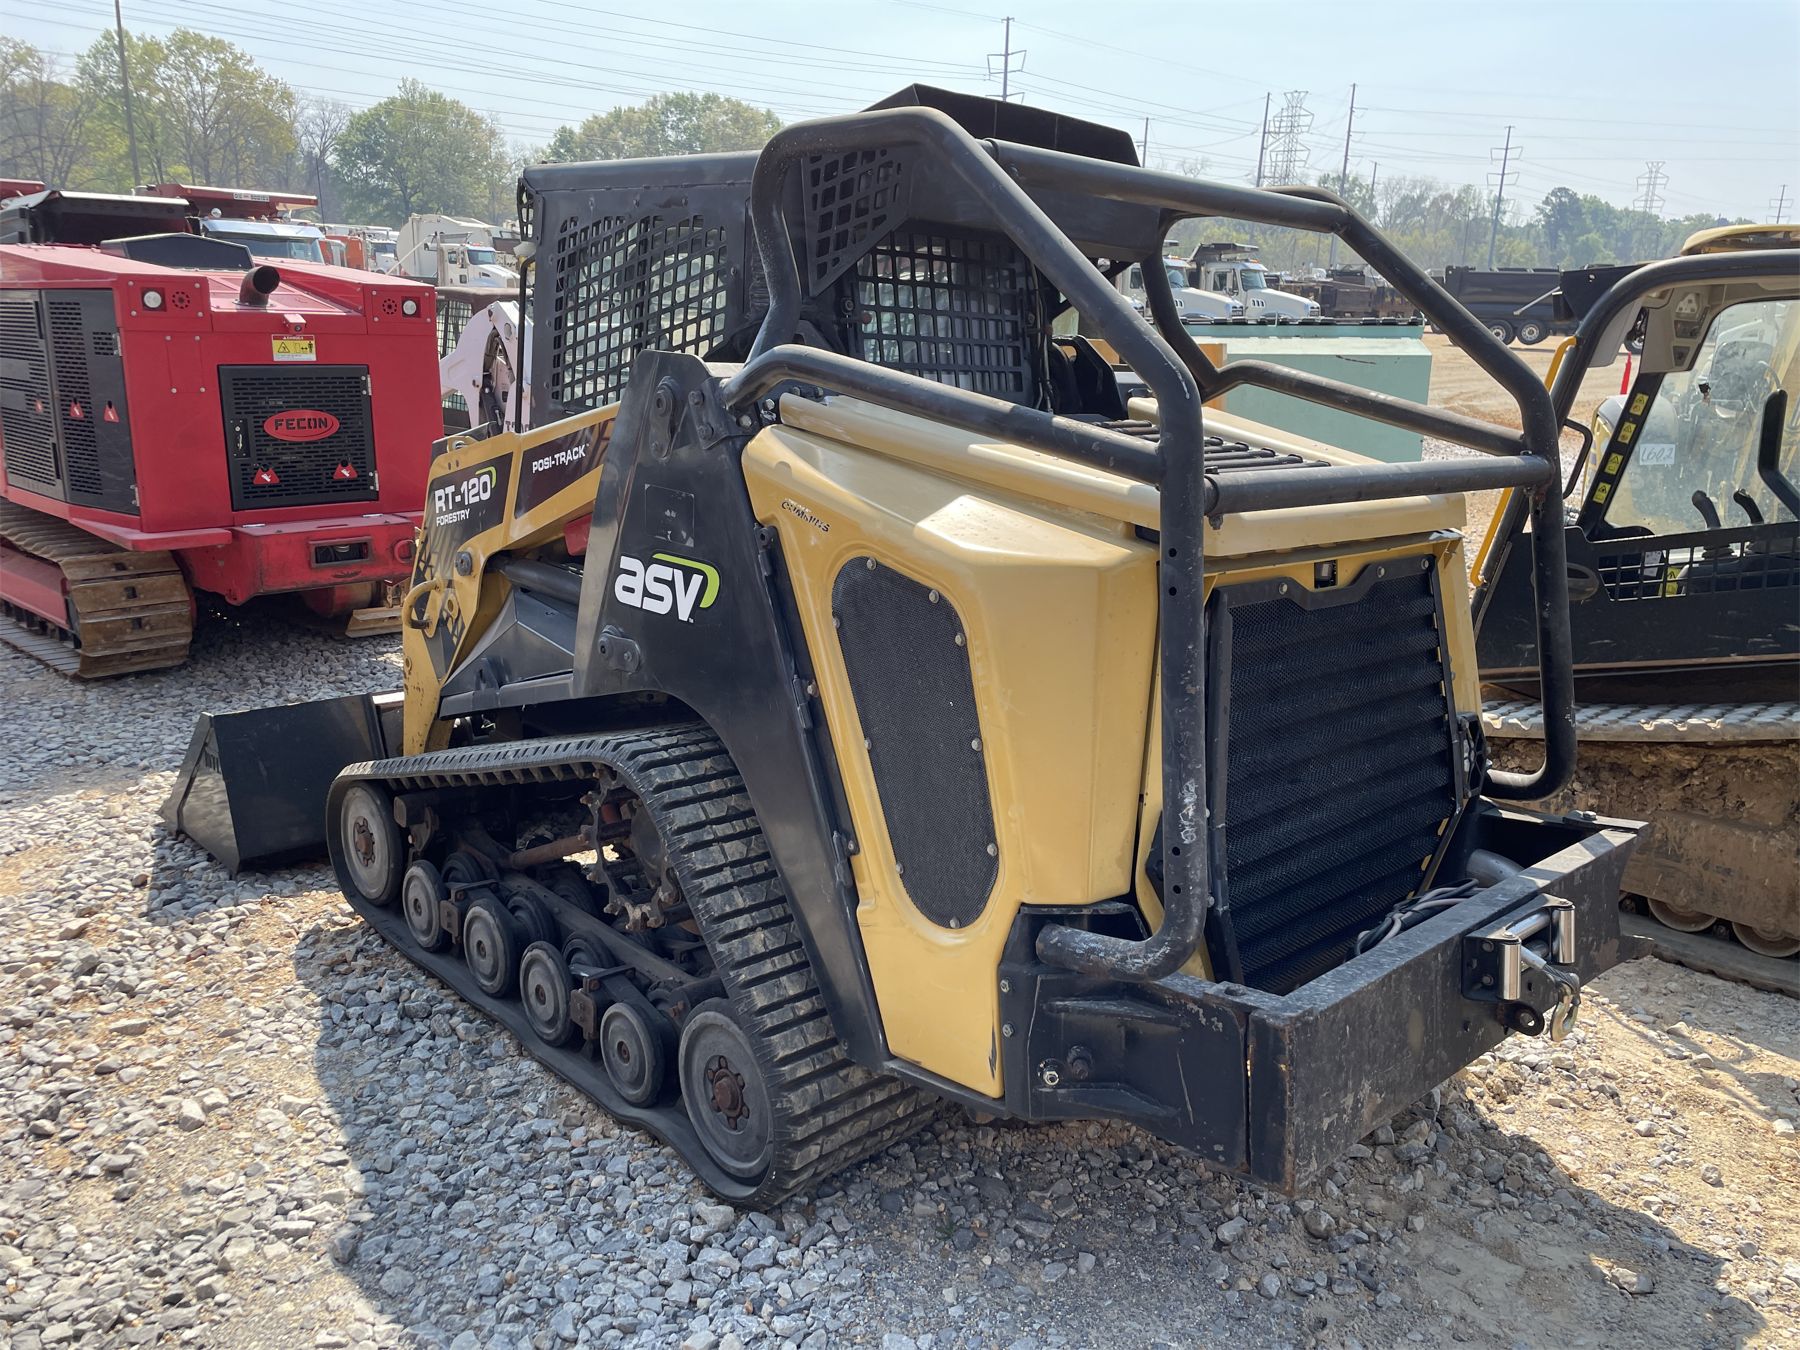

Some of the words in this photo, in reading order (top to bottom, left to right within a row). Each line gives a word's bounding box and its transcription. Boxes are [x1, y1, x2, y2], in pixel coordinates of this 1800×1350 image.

[274, 417, 328, 431] FECON
[532, 443, 586, 474] POSI-TRACK
[434, 474, 491, 514] RT-120
[436, 508, 470, 526] FORESTRY
